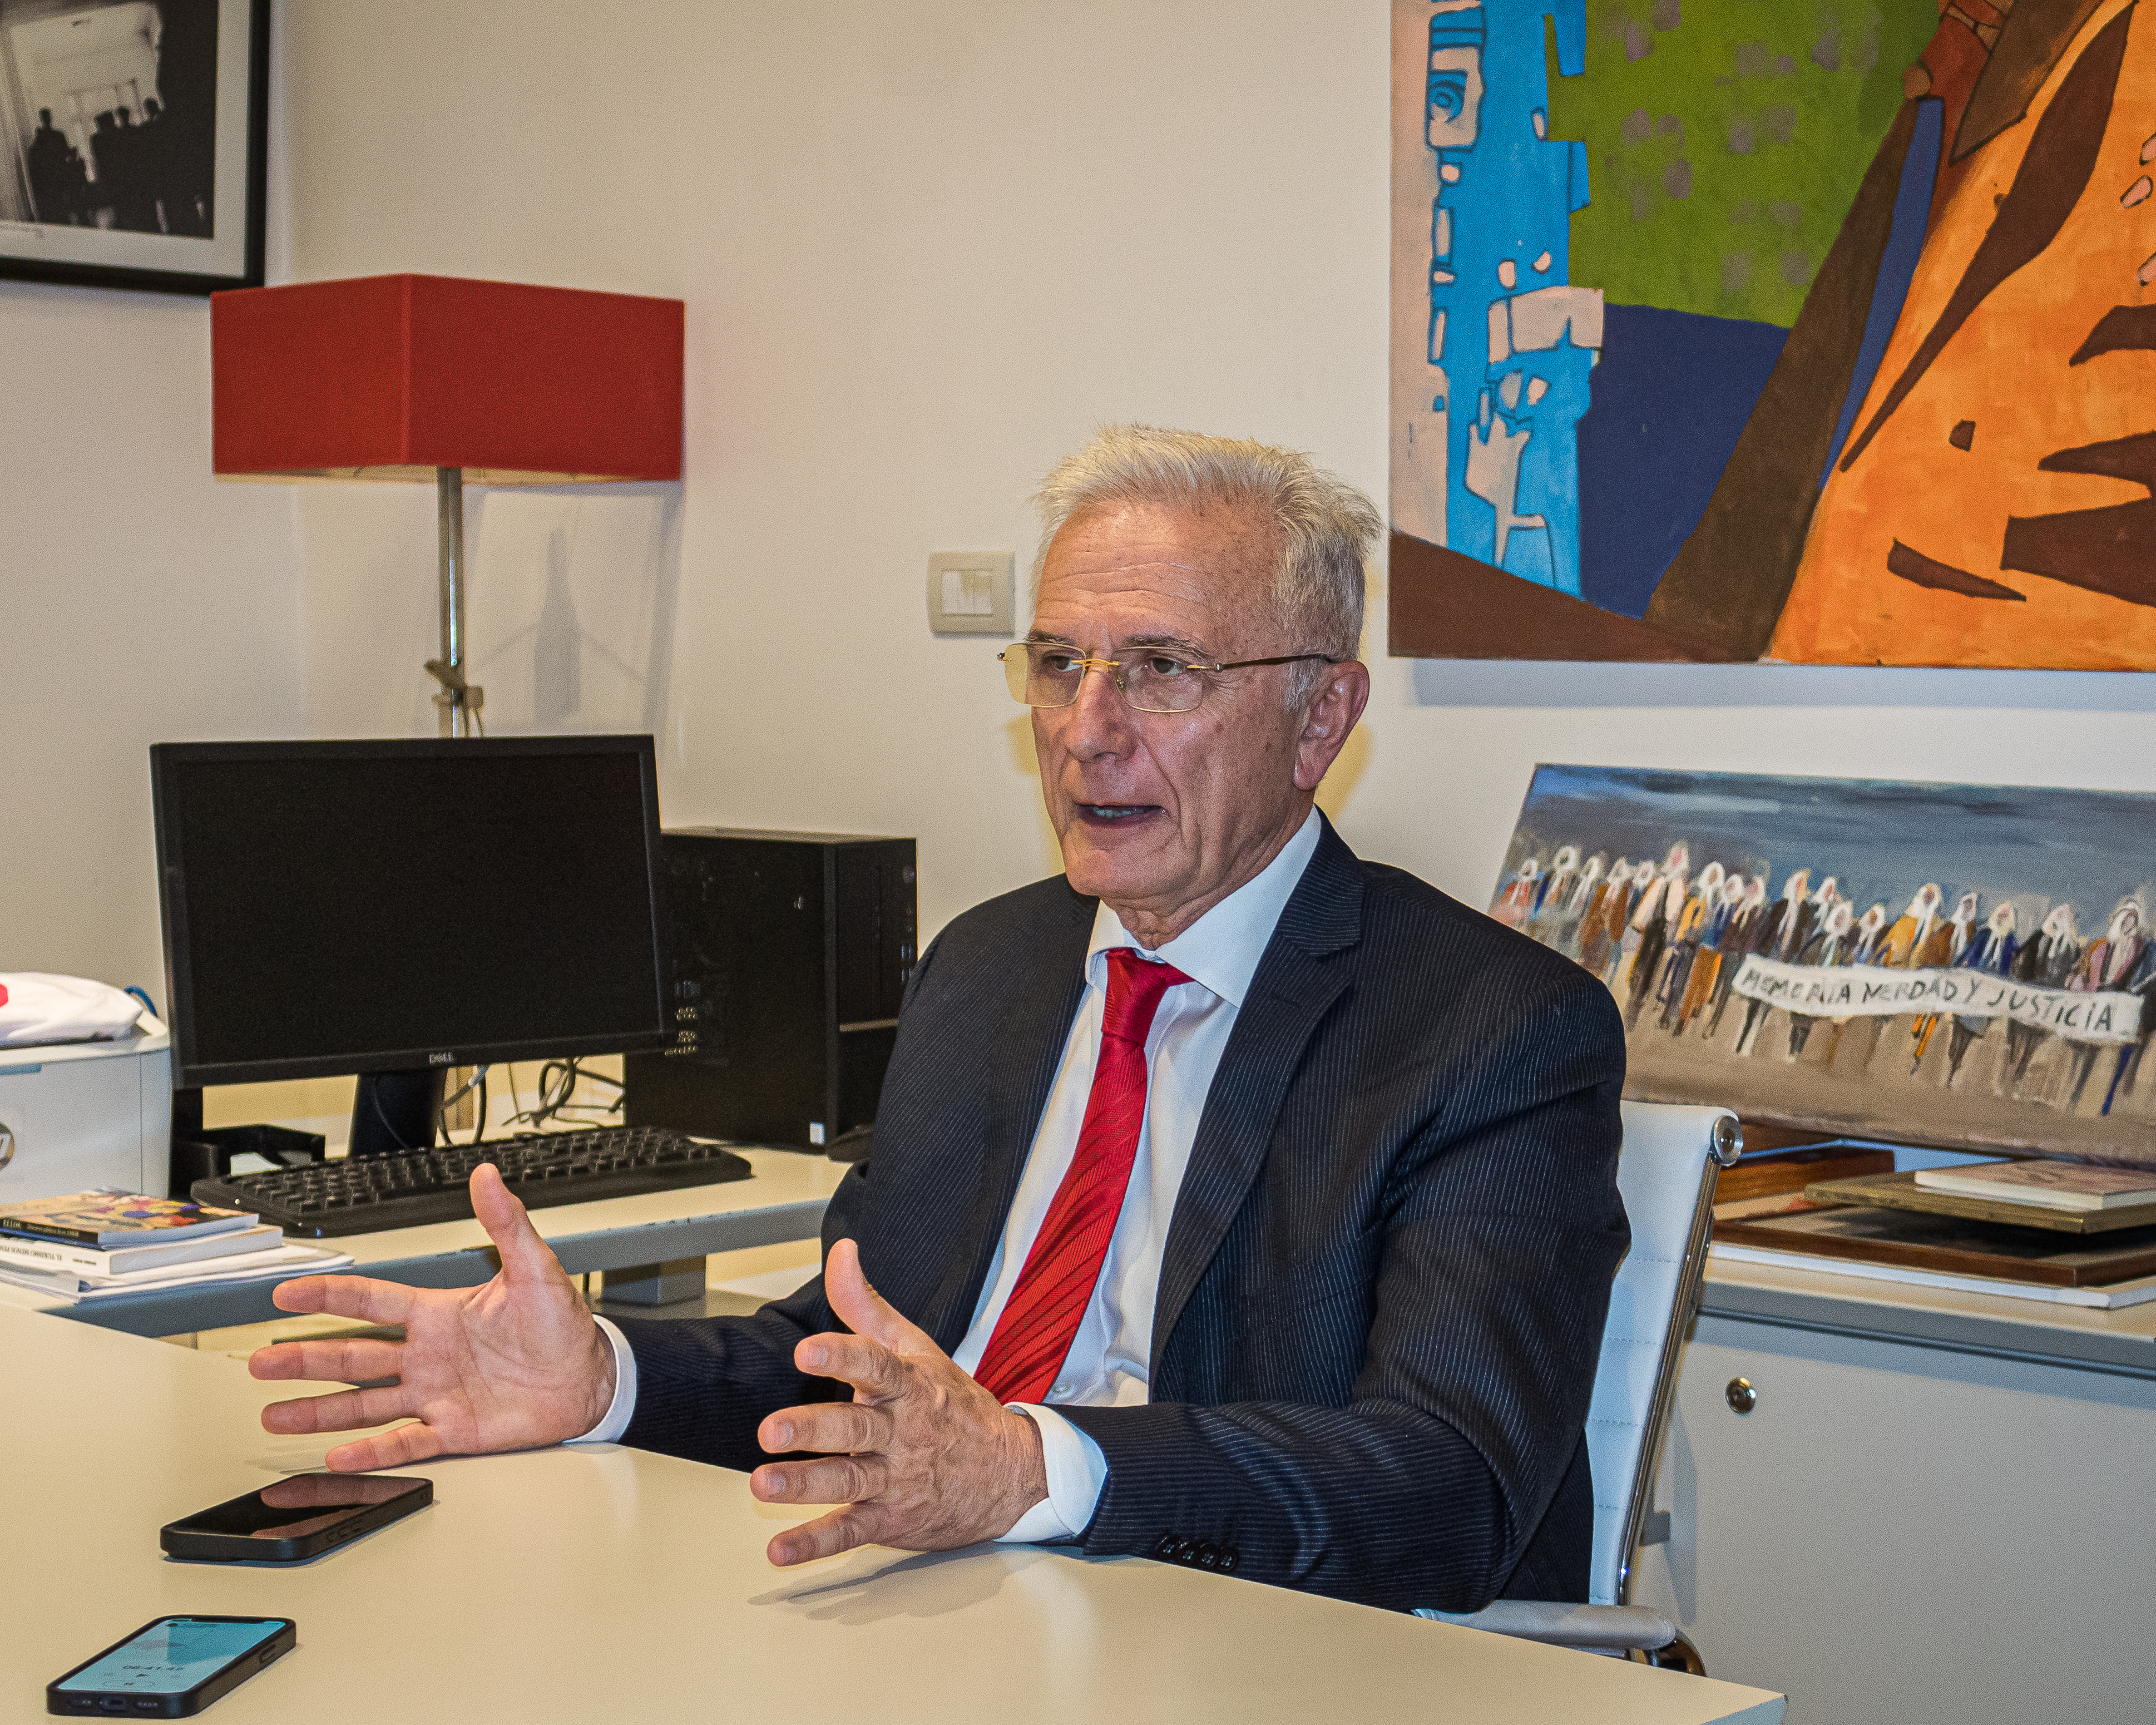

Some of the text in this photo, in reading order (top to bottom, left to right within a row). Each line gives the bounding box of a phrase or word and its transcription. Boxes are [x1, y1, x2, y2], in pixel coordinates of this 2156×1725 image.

[1964, 977, 1982, 1005] Y
[1986, 988, 2112, 1031] JUSTICIA
[429, 1052, 453, 1065] DELL
